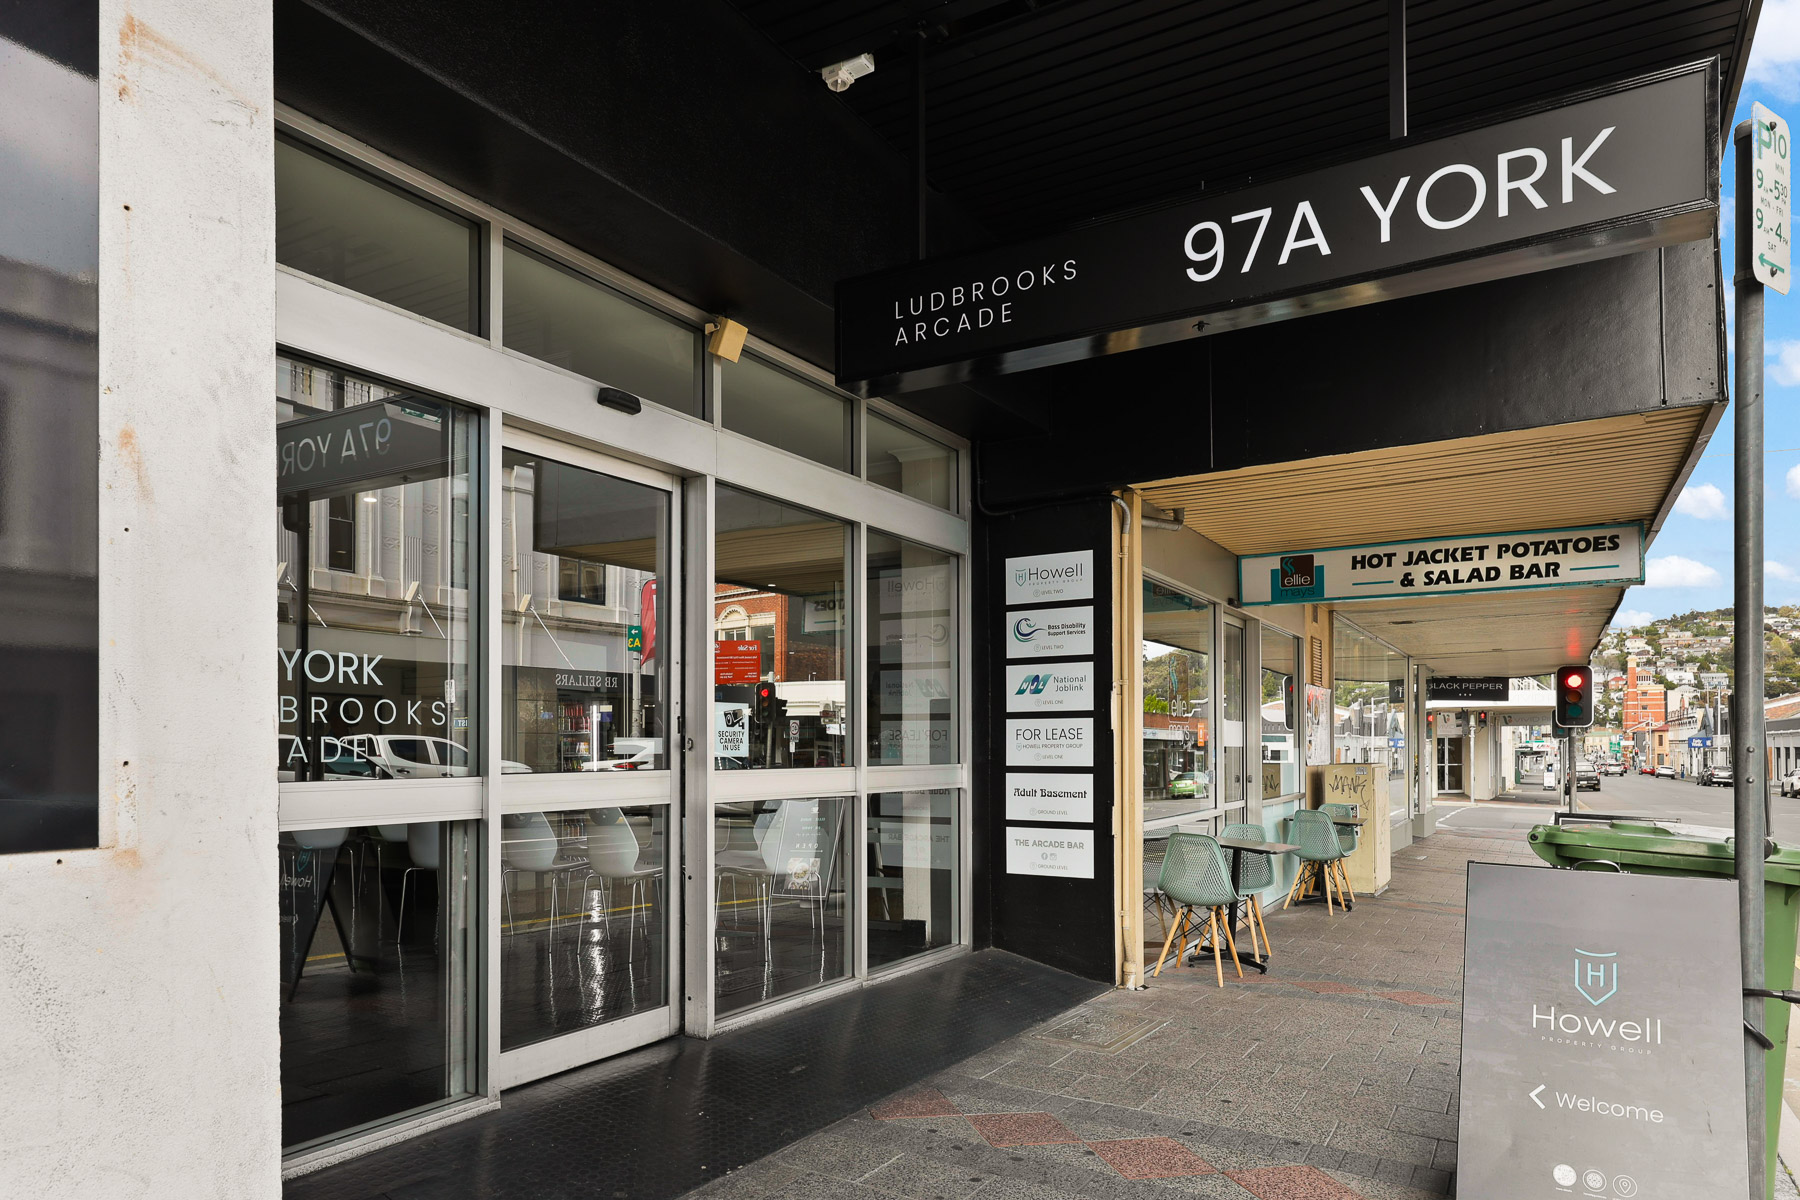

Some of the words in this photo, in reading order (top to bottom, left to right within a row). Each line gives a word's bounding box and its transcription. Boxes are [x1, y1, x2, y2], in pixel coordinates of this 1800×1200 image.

[1184, 200, 1332, 282] 97A
[1359, 126, 1617, 243] YORK
[895, 260, 1078, 320] LUDBROOKS
[894, 302, 1012, 346] ARCADE
[1351, 552, 1396, 570] HOT
[1402, 545, 1490, 567] JACKET
[1496, 534, 1620, 559] POTATOES
[1028, 563, 1082, 580] Howell
[1284, 574, 1311, 586] ellie
[1400, 572, 1415, 588] &
[1424, 566, 1501, 586] SALAD
[1510, 562, 1560, 580] BAR
[1280, 587, 1315, 598] mays
[1061, 622, 1086, 630] Disability
[278, 648, 384, 686] YORK
[1053, 675, 1086, 684] National
[1056, 684, 1084, 692] Joblink
[1462, 682, 1503, 690] PEPPER
[1015, 728, 1041, 740] FOR
[1045, 728, 1083, 740] LEASE
[1014, 788, 1037, 797] Adult
[1040, 789, 1087, 798] Basement
[1032, 840, 1065, 848] ARCADE
[1067, 842, 1084, 850] BAR
[1532, 1004, 1662, 1044] Howell
[1541, 1036, 1602, 1048] PROPERTY
[1611, 1045, 1652, 1054] GROUP
[1555, 1091, 1664, 1123] Welcome
